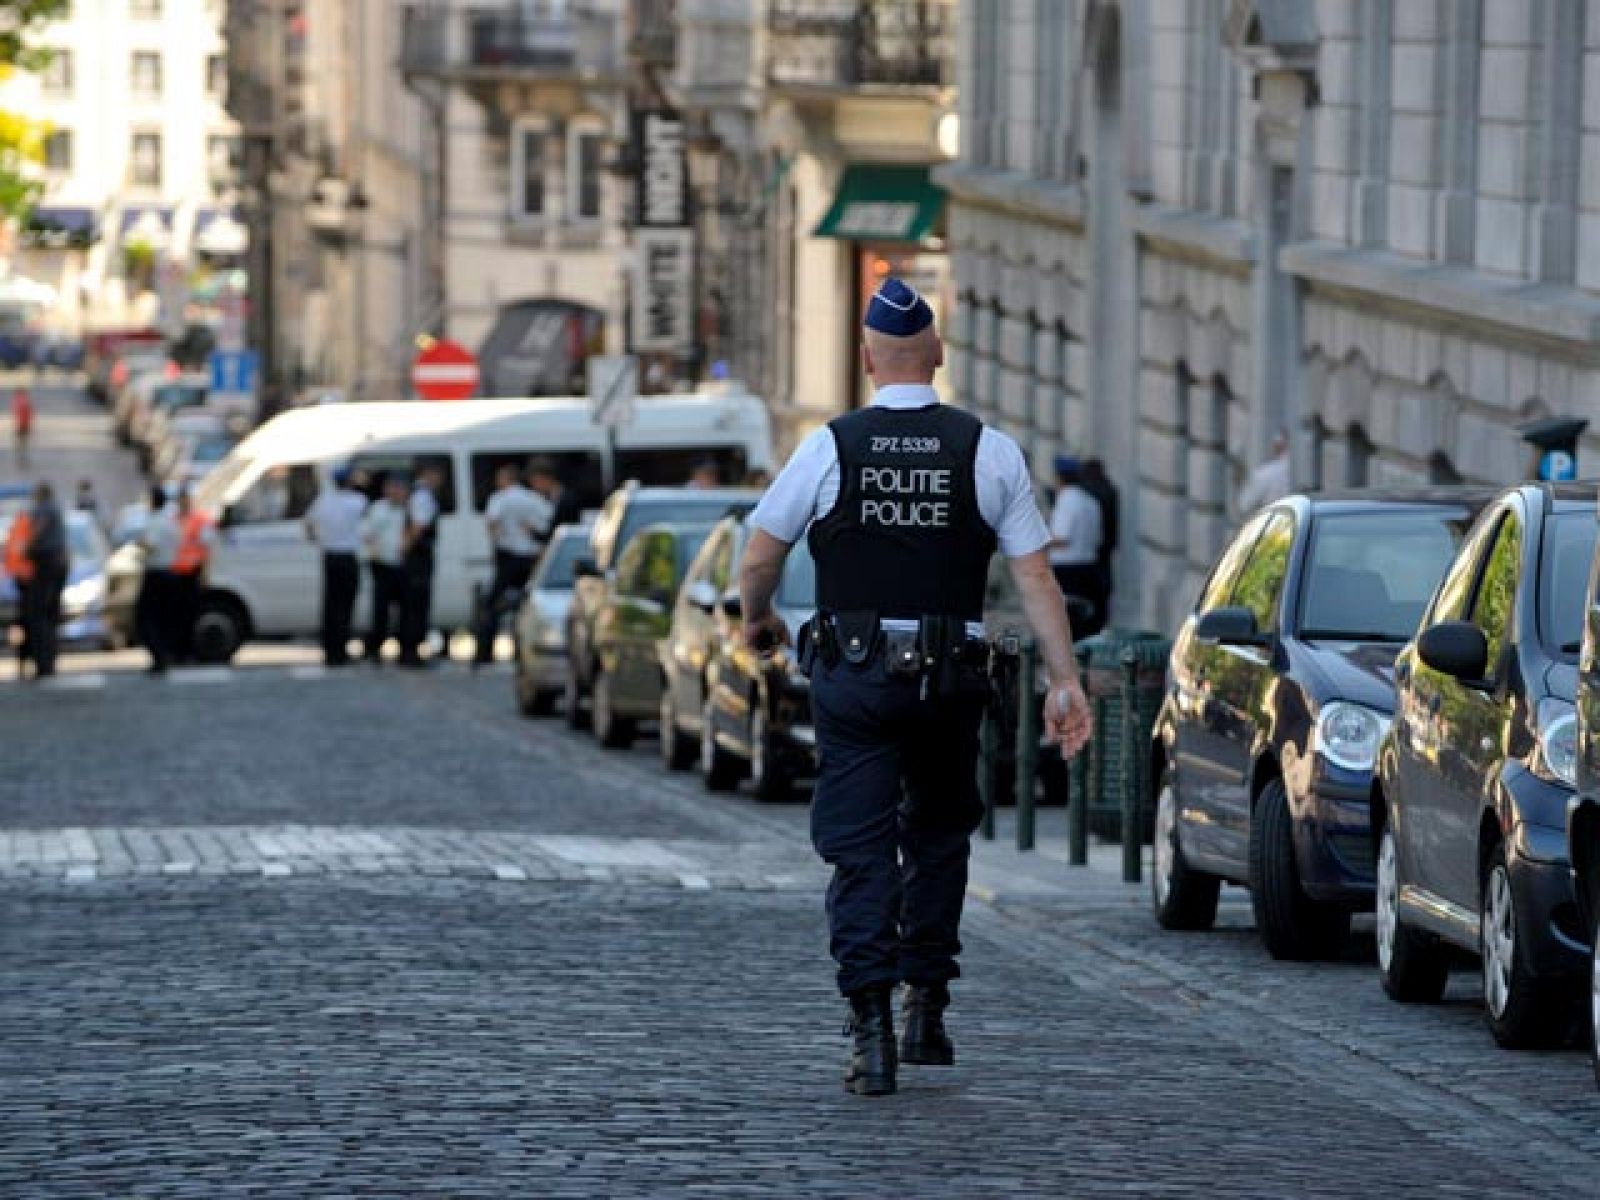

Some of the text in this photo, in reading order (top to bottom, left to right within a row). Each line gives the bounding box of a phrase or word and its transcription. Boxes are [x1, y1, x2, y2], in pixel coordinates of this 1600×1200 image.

[870, 436, 900, 453] ZPZ
[1549, 450, 1571, 480] P
[860, 467, 951, 494] POLITIE
[860, 500, 950, 526] POLICE
